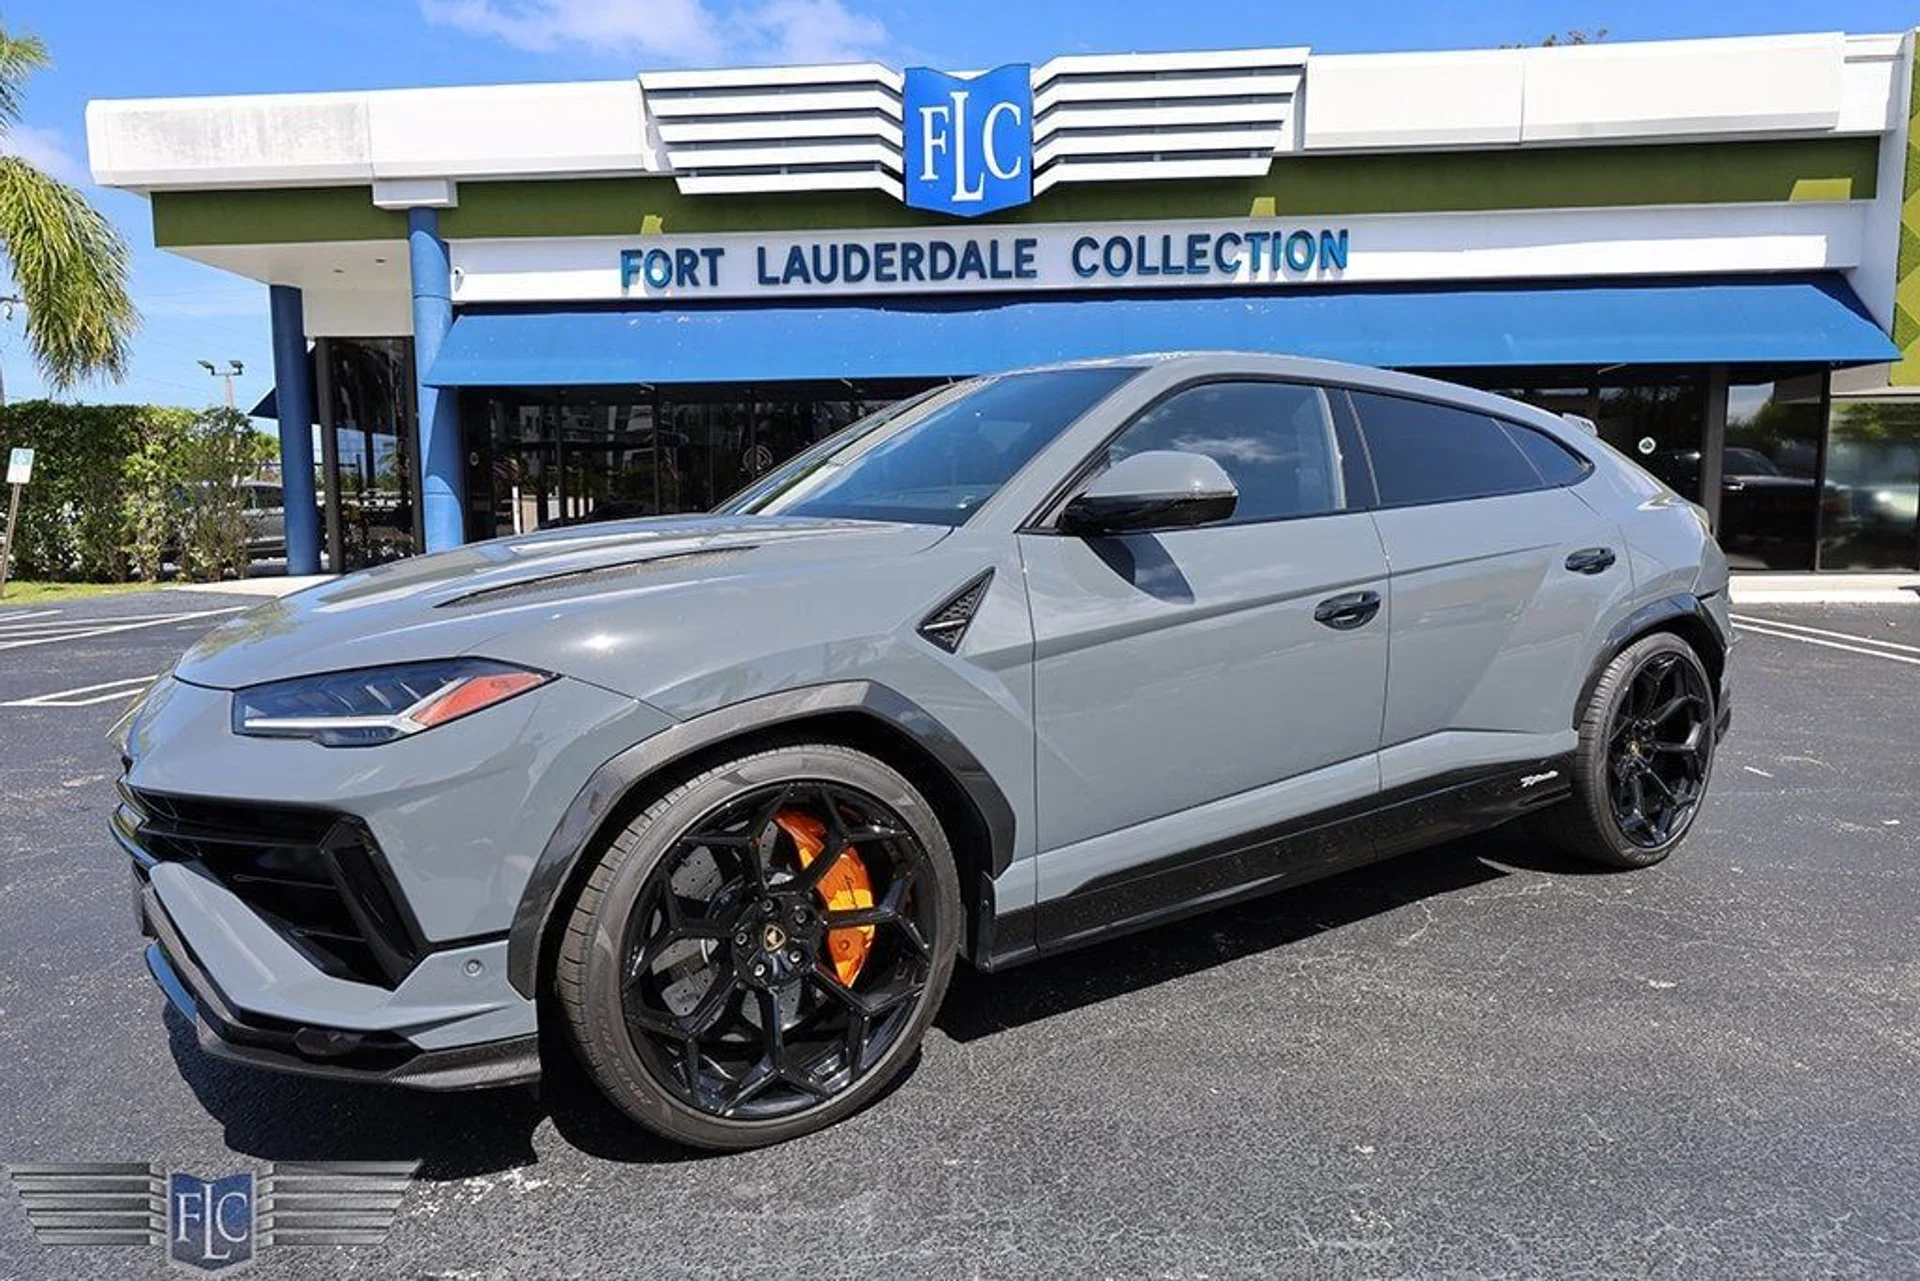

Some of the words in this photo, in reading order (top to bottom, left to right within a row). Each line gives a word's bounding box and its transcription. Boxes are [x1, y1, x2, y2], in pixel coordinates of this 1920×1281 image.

[919, 91, 1022, 202] FLC
[620, 246, 725, 288] FORT
[756, 238, 1038, 286] LAUDERDALE
[1072, 229, 1349, 277] COLLECTION
